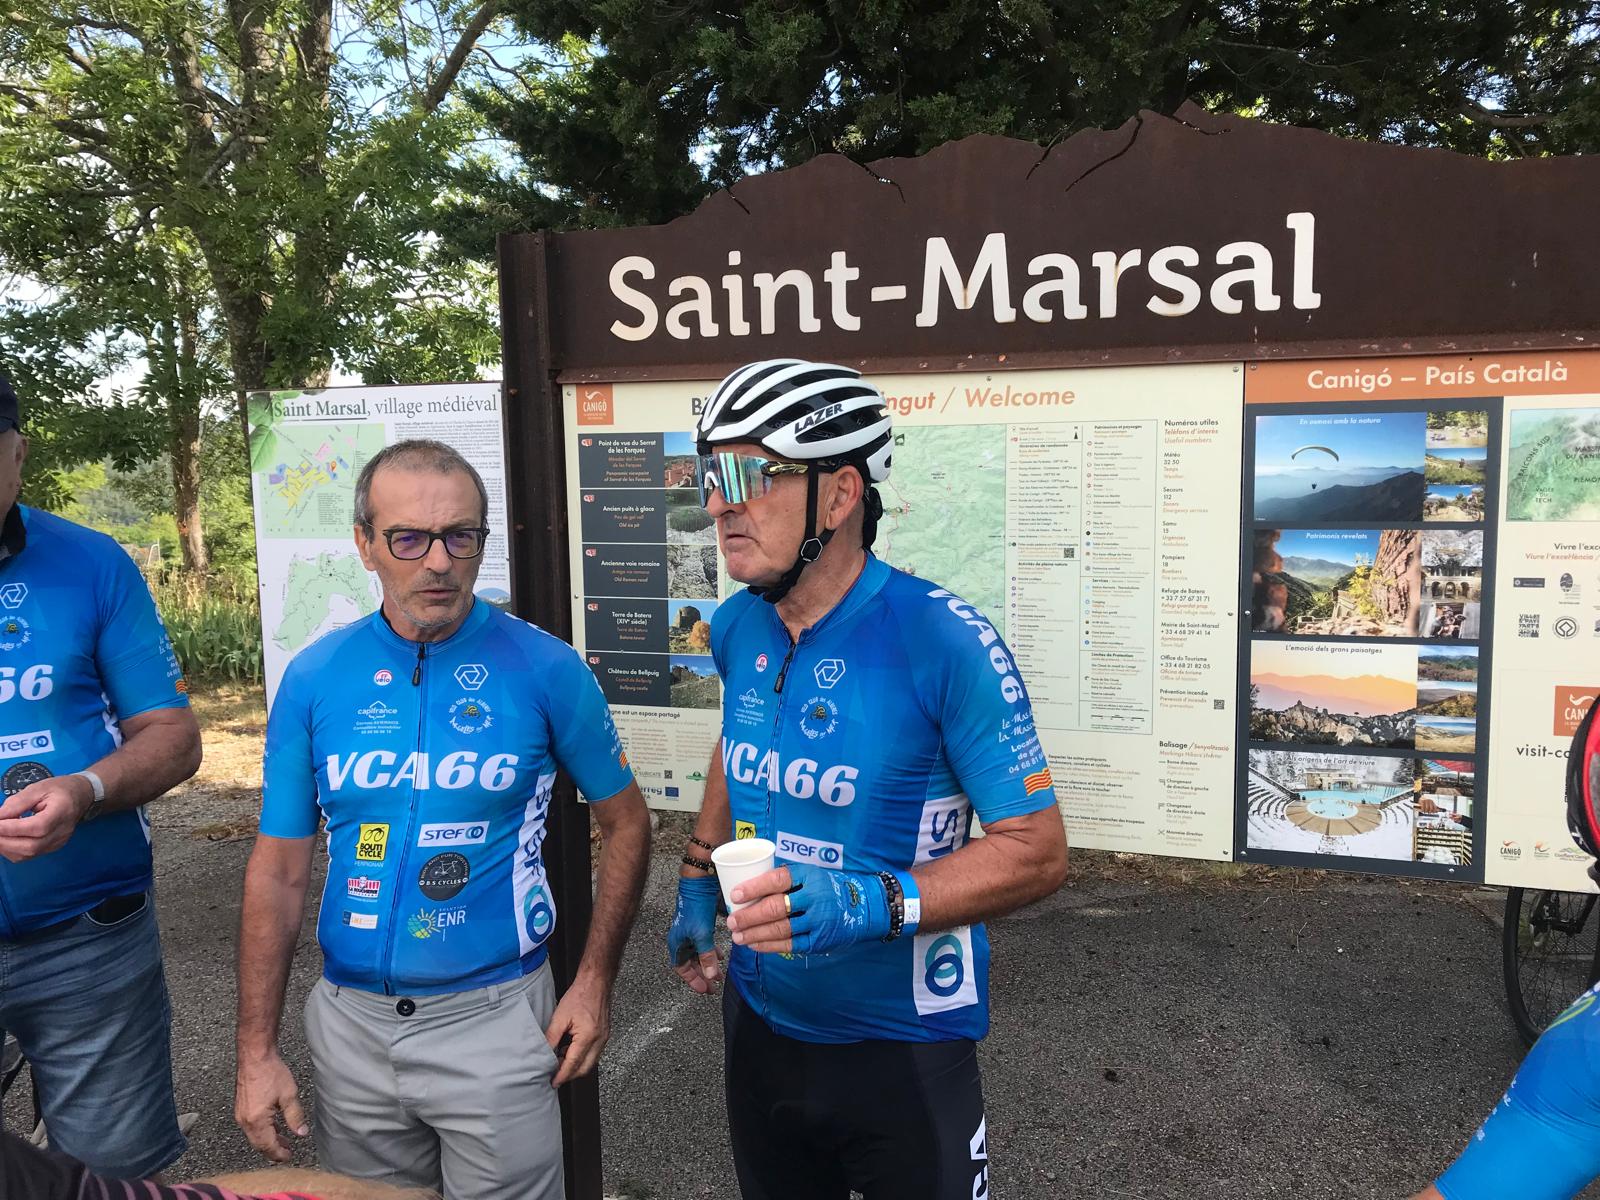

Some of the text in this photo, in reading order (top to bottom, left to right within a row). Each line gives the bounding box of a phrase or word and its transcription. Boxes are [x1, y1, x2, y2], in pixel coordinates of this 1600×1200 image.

[609, 212, 1321, 341] Saint-Marsal
[1307, 368, 1392, 393] Canigó
[1426, 364, 1475, 385] País
[1483, 360, 1568, 383] Català
[273, 393, 497, 419] Saint Marsal, village médiéval
[965, 385, 1076, 408] Welcome
[794, 402, 844, 435] LAZER
[1350, 647, 1382, 655] paisatges
[1160, 740, 1187, 749] Balisage
[326, 750, 520, 792] VCA66
[722, 735, 860, 807] VCA66
[359, 849, 382, 858] CYCLE
[437, 910, 465, 927] ENR
